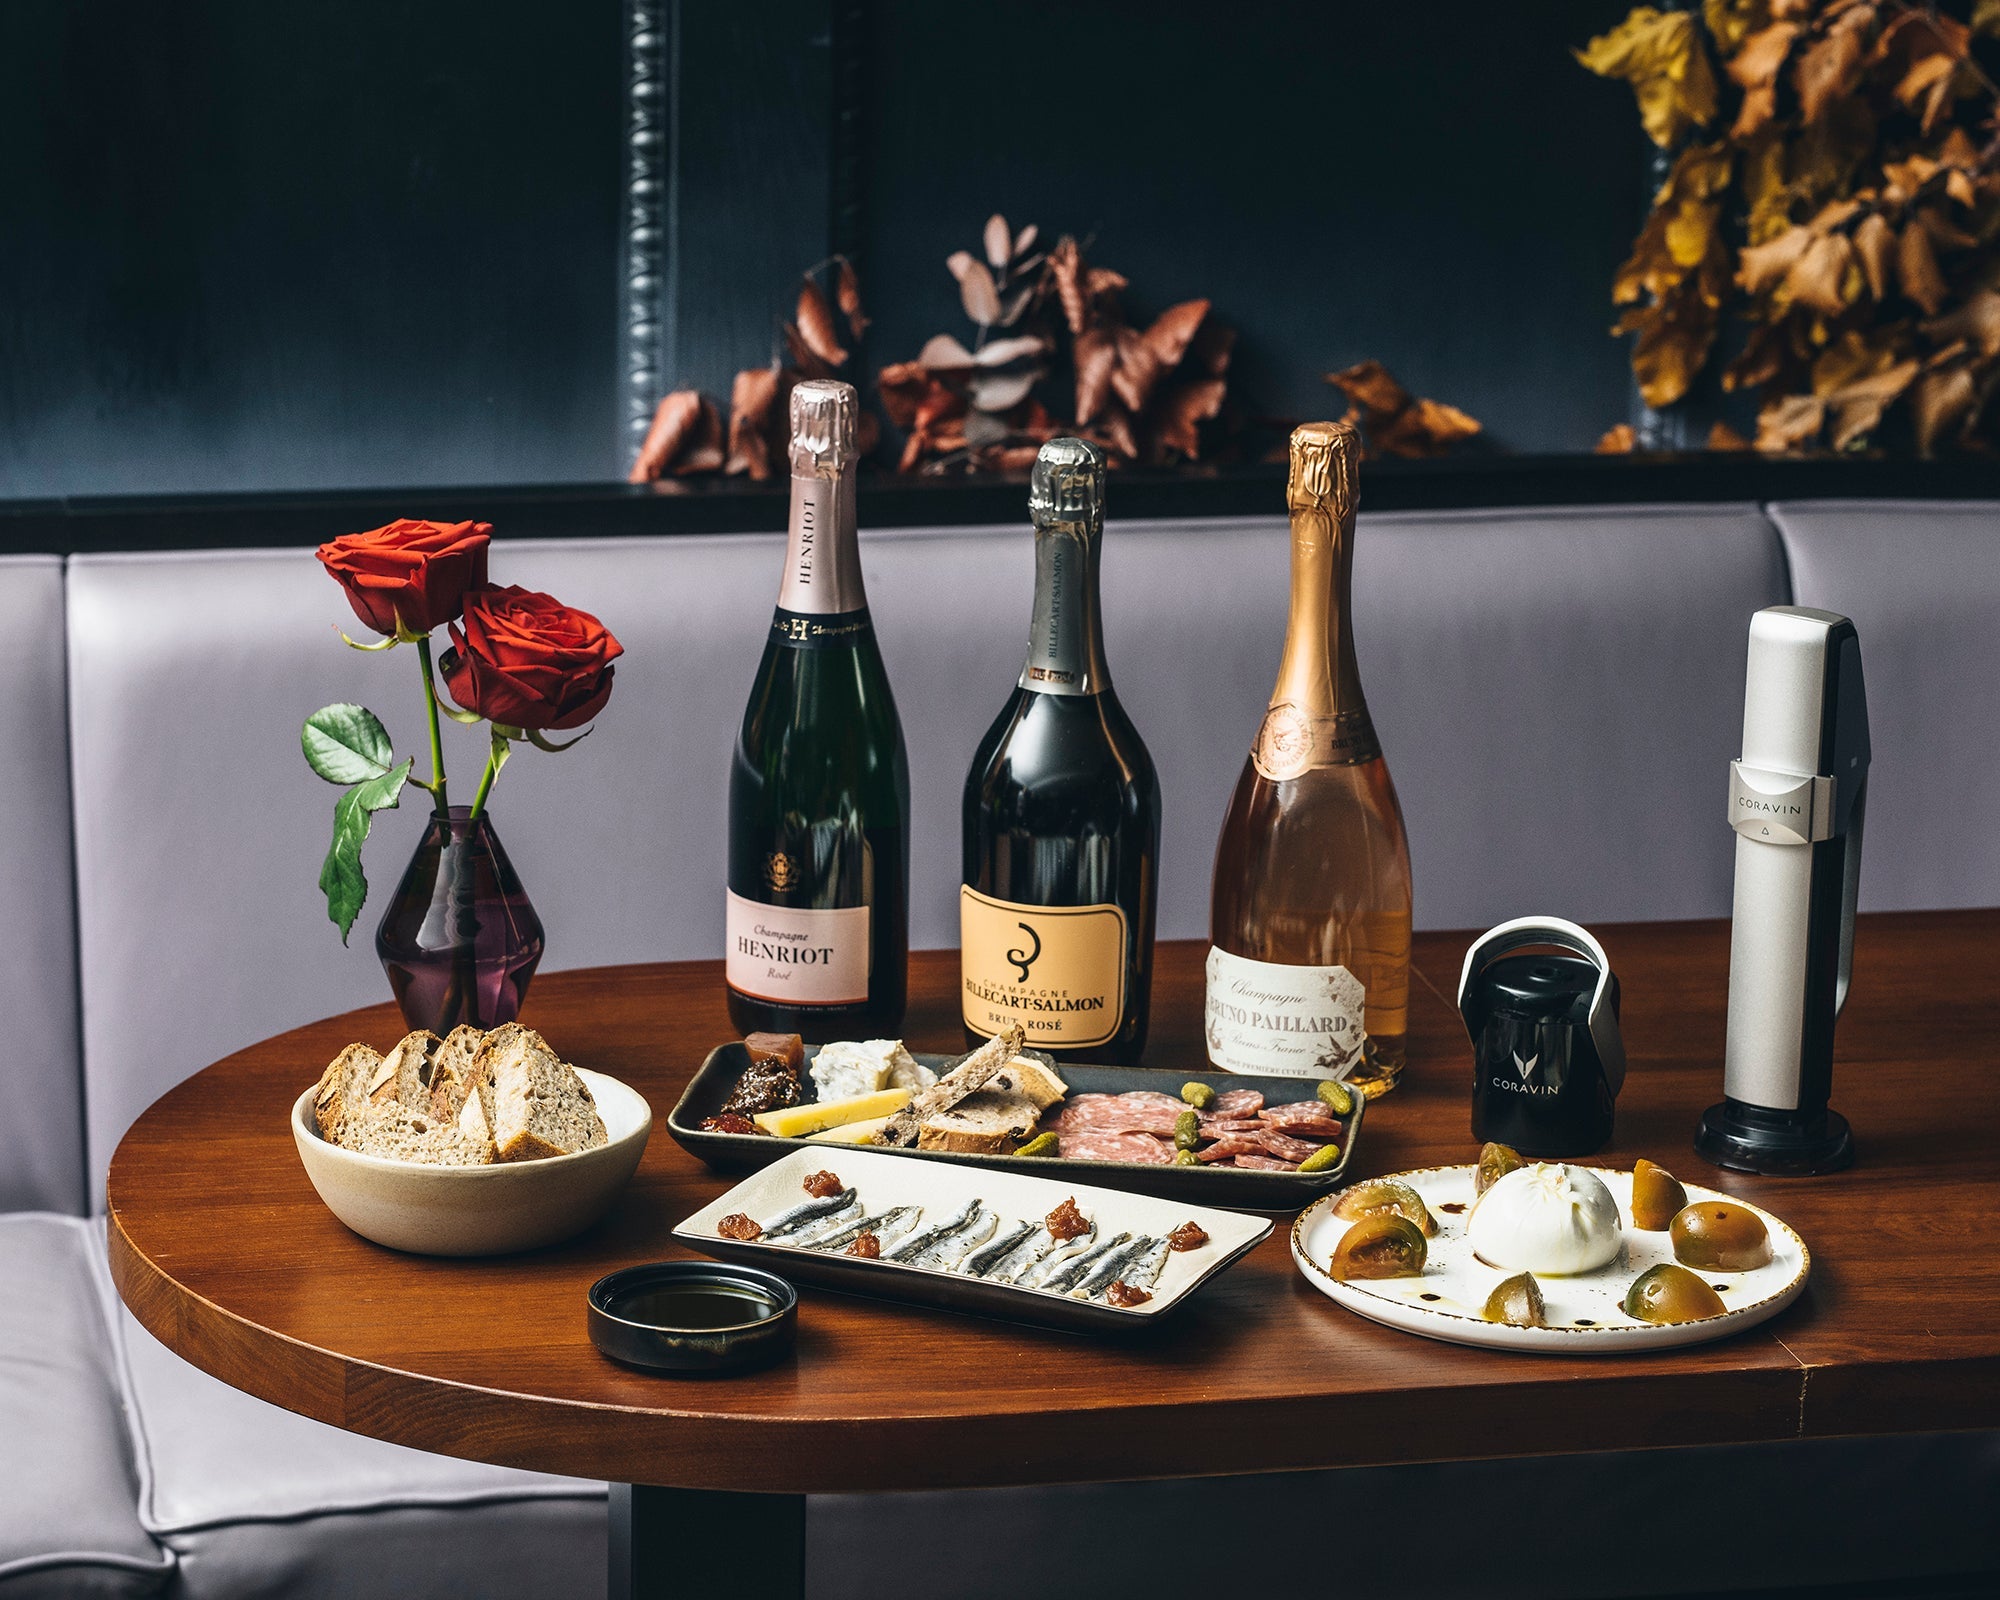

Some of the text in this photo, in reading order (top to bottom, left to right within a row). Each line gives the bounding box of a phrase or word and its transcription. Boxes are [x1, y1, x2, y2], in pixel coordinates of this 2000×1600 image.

[799, 498, 816, 585] HENRIOT
[1738, 796, 1802, 815] CORAVIN
[753, 924, 810, 943] Champagne
[738, 936, 834, 965] HENRIOT
[767, 967, 793, 981] Rosé
[965, 977, 1105, 1012] BILLECART-SALMON
[983, 978, 1070, 998] CHAMPAGNE
[1229, 975, 1307, 1007] Champagne
[988, 1011, 1063, 1032] BRUT ROSÉ
[1209, 995, 1348, 1034] BRUNO PAILLARD
[1492, 1077, 1560, 1096] CORAVIN
